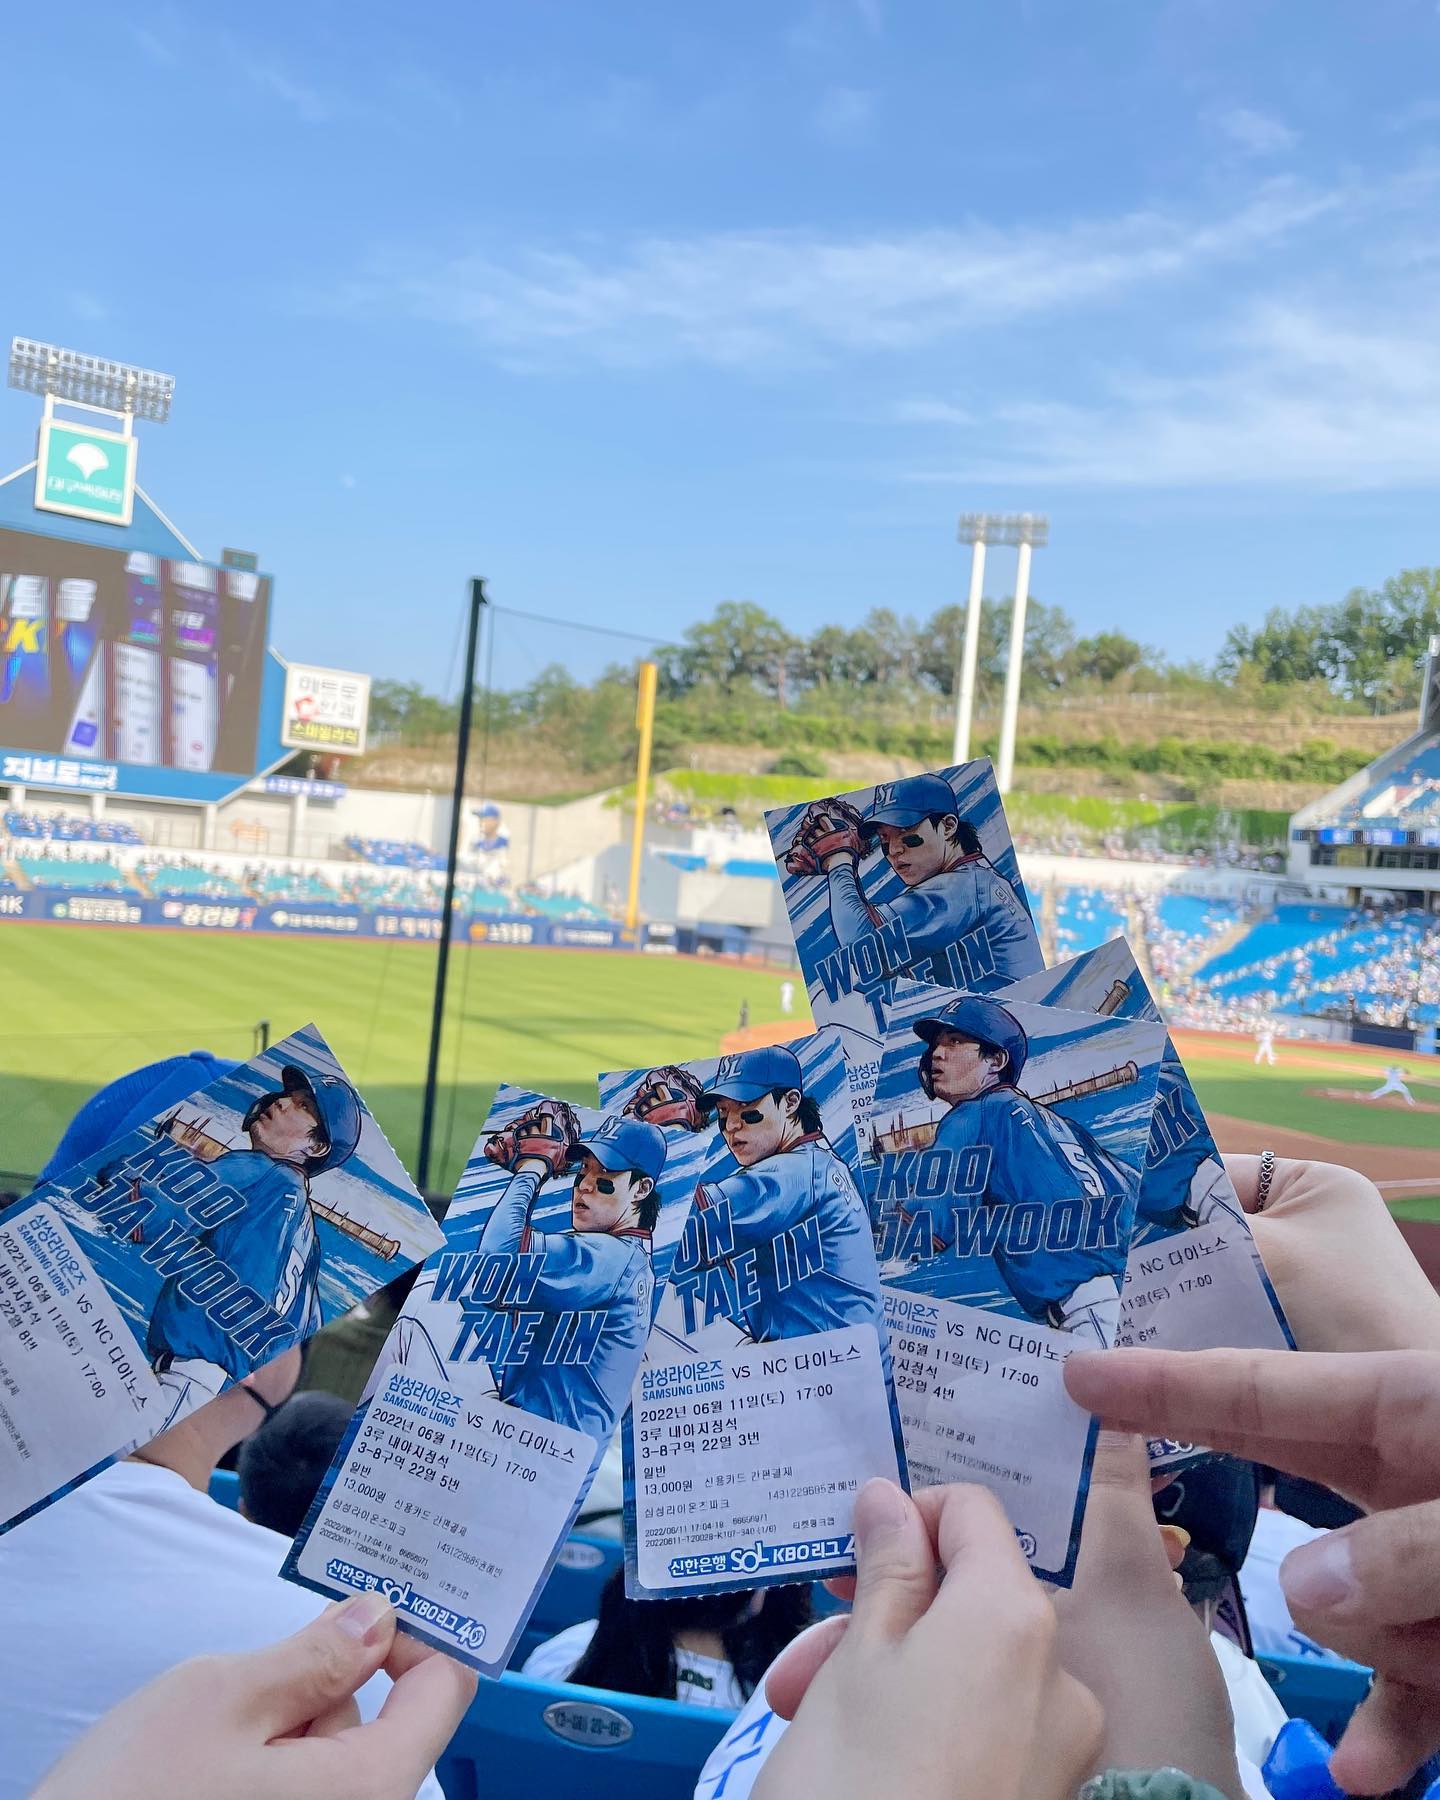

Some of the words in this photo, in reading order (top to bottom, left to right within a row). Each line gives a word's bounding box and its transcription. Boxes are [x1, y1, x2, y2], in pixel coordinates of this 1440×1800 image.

[815, 916, 912, 1004] WON
[850, 1079, 877, 1092] SAMS
[125, 1133, 247, 1229] KOO
[876, 1145, 992, 1201] KOO
[673, 1198, 735, 1275] ON
[952, 1194, 1126, 1258] WOOK
[16, 1224, 53, 1270] SAMSUNG
[47, 1268, 70, 1297] LIONS
[70, 1176, 157, 1241] JA
[140, 1219, 298, 1359] WOOK
[675, 1248, 761, 1336] TAE
[772, 1215, 824, 1292] IN
[1139, 1257, 1164, 1276] NC
[1168, 1236, 1229, 1266] 다이노스
[429, 1252, 547, 1304] WON
[1178, 1274, 1213, 1293] 17:00
[28, 1214, 87, 1291] 삼성라이온즈
[76, 1293, 93, 1314] VS
[91, 1318, 114, 1345] NC
[108, 1346, 148, 1413] 다이노스
[883, 1296, 939, 1326] 라이온즈
[946, 1321, 964, 1337] VS
[976, 1326, 1001, 1344] NC
[906, 1323, 936, 1339] LIONS
[445, 1311, 544, 1366] TAE
[543, 1310, 609, 1366] IN
[81, 1362, 106, 1398] 17:00
[641, 1360, 724, 1389] 삼성라이온즈
[732, 1366, 751, 1379] VS
[762, 1358, 788, 1375] NC
[794, 1344, 861, 1370] 다이노스
[898, 1339, 929, 1357] 06월
[936, 1349, 989, 1374] 11일(토)
[1001, 1366, 1039, 1387] 17:00
[383, 1391, 429, 1417] SAMSUNG
[428, 1409, 457, 1428] LIONS
[640, 1405, 687, 1423] 2022년
[693, 1400, 722, 1415] 06월
[730, 1390, 785, 1410] 11일(토)
[797, 1383, 833, 1400] 17:00
[642, 1385, 693, 1401] SAMSUNG
[695, 1380, 725, 1394] LIONS
[933, 1386, 955, 1402] 4번
[364, 1425, 385, 1442] 3루
[388, 1373, 464, 1415] 삼성라이온즈
[466, 1411, 484, 1428] VS
[491, 1419, 516, 1439] NC
[518, 1430, 576, 1464] 다이노스
[640, 1427, 662, 1442] 3루
[371, 1408, 415, 1434] 2022년
[417, 1426, 446, 1446] 06월
[450, 1438, 498, 1467] 11일(토)
[505, 1461, 537, 1482] 17:00
[642, 1440, 695, 1459] 3-8구역
[702, 1435, 732, 1452] 22열
[738, 1431, 760, 1446] 3번
[349, 1461, 372, 1479] 일반
[357, 1441, 406, 1470] 3-8구역
[408, 1462, 437, 1483] 22열
[439, 1474, 460, 1493] 5번
[643, 1465, 666, 1480] 일반
[645, 1479, 693, 1495] 13,000원
[705, 1472, 746, 1488] 신용카드
[751, 1466, 793, 1481] 간편결제
[332, 1499, 407, 1536] 삼성라이온즈파크
[394, 1499, 431, 1521] 신용카드
[644, 1499, 730, 1518] 삼성라이온즈파크
[670, 1554, 727, 1577] 신한은행
[730, 1541, 769, 1573] SOL
[327, 1561, 379, 1591] 신한은행
[381, 1578, 412, 1607] SOL
